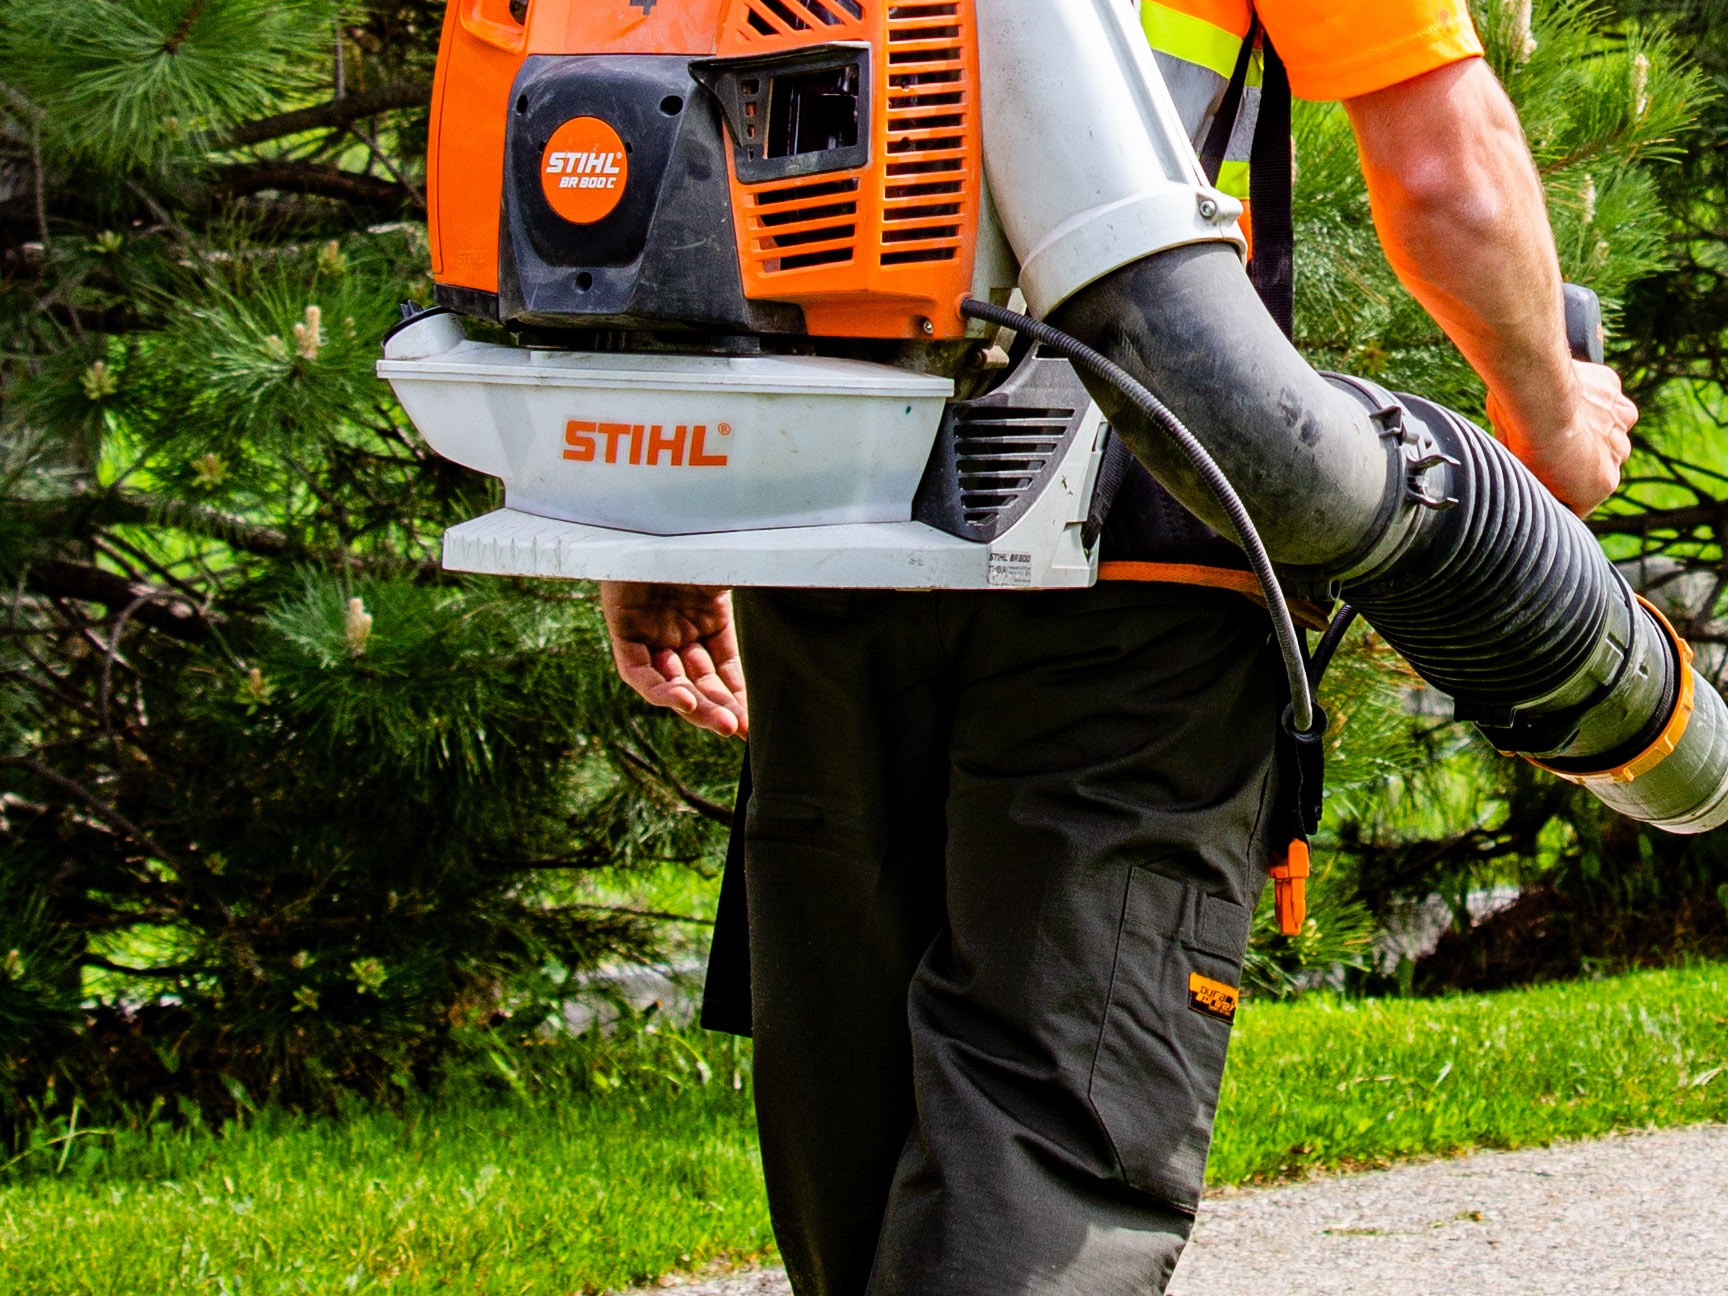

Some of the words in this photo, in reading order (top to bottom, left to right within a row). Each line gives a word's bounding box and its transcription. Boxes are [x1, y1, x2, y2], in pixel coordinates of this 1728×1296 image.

[559, 176, 579, 189] BR
[579, 176, 606, 189] 800
[606, 177, 617, 189] C
